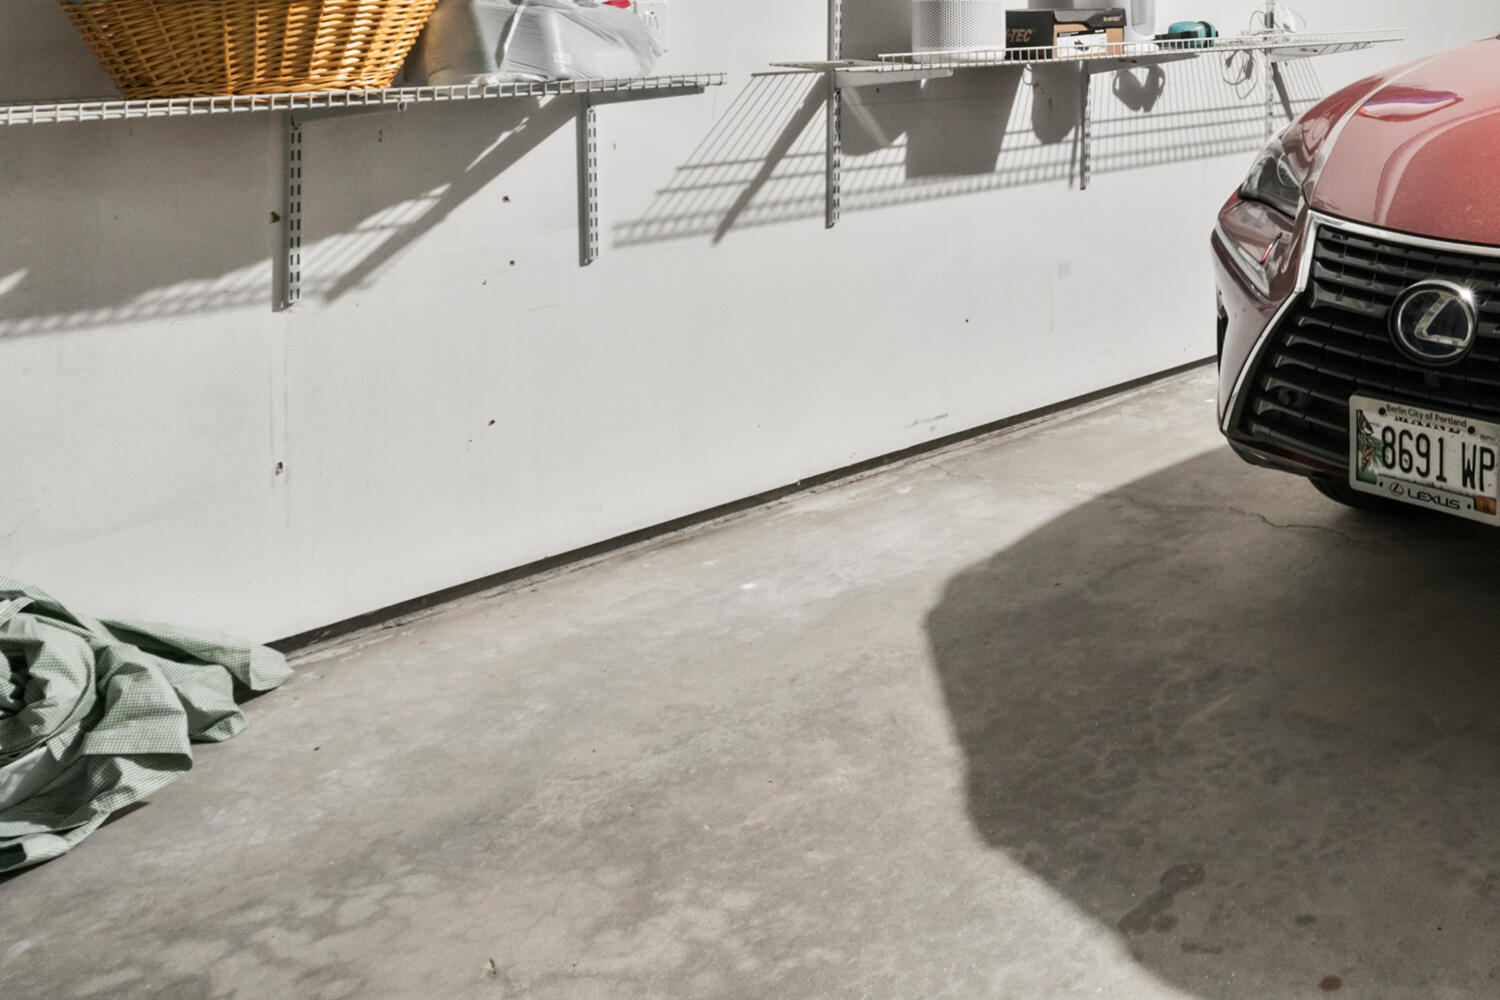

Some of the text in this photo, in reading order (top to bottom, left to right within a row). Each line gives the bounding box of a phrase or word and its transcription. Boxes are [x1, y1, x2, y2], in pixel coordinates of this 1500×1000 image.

[1006, 28, 1033, 42] -TEC
[1386, 404, 1406, 414] Berlin
[1407, 408, 1424, 420] City
[1425, 411, 1433, 421] of
[1434, 414, 1467, 428] Portland
[1381, 425, 1496, 493] 8691 WP
[1407, 487, 1461, 511] LEXUS
